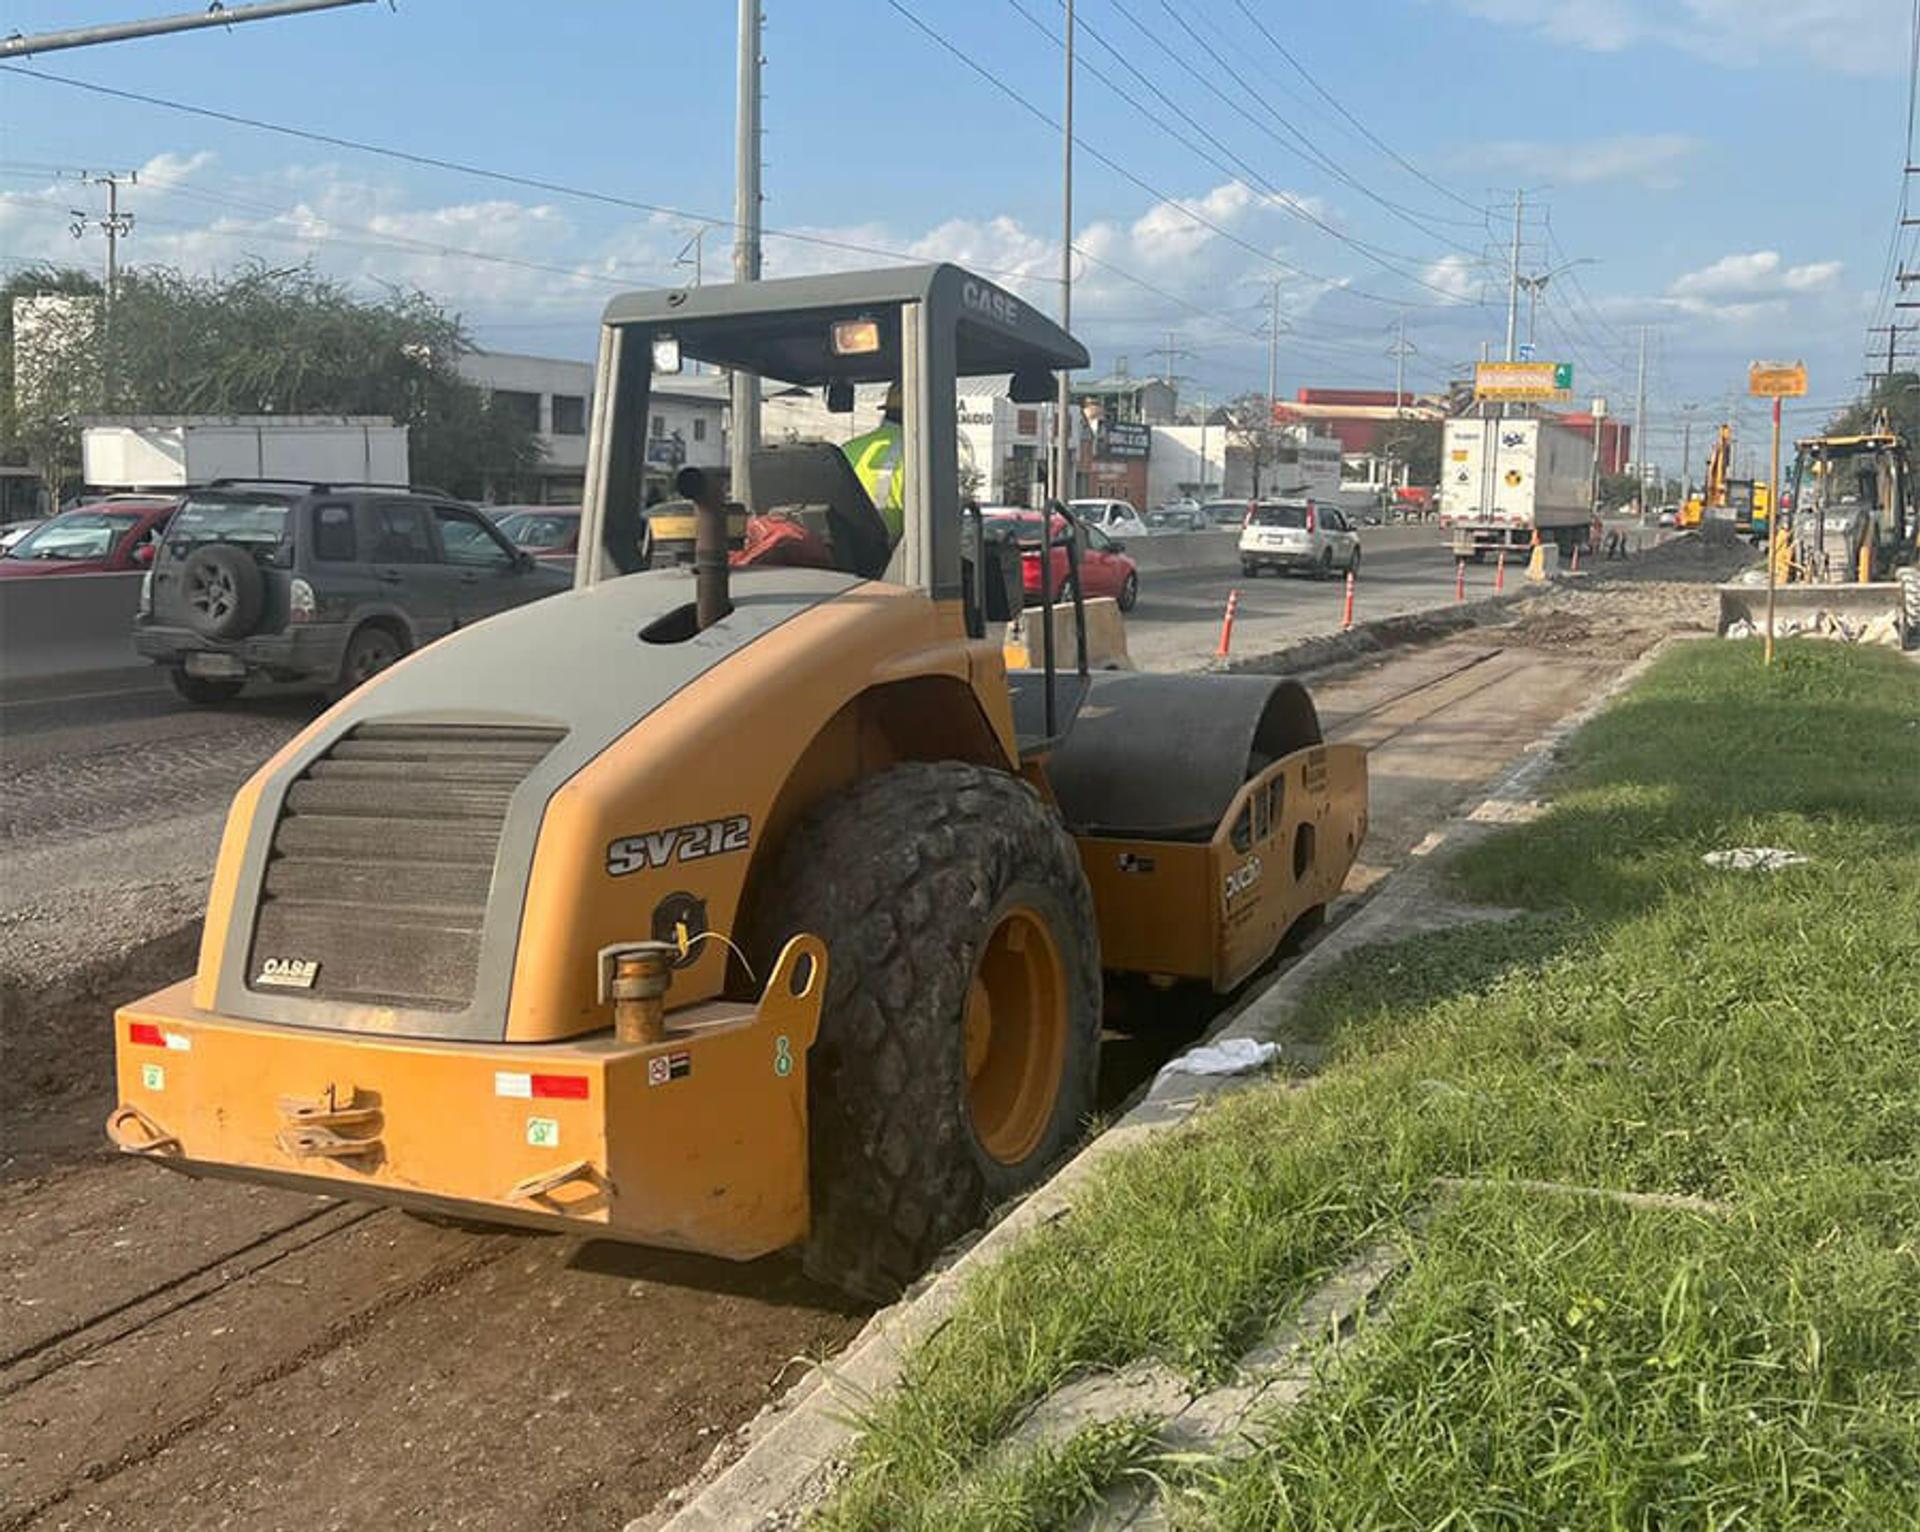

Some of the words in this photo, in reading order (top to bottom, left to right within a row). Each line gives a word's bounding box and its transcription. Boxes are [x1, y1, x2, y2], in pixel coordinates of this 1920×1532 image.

[963, 281, 1019, 326] CASE
[606, 814, 751, 877] SV212
[263, 957, 319, 977] CASE
